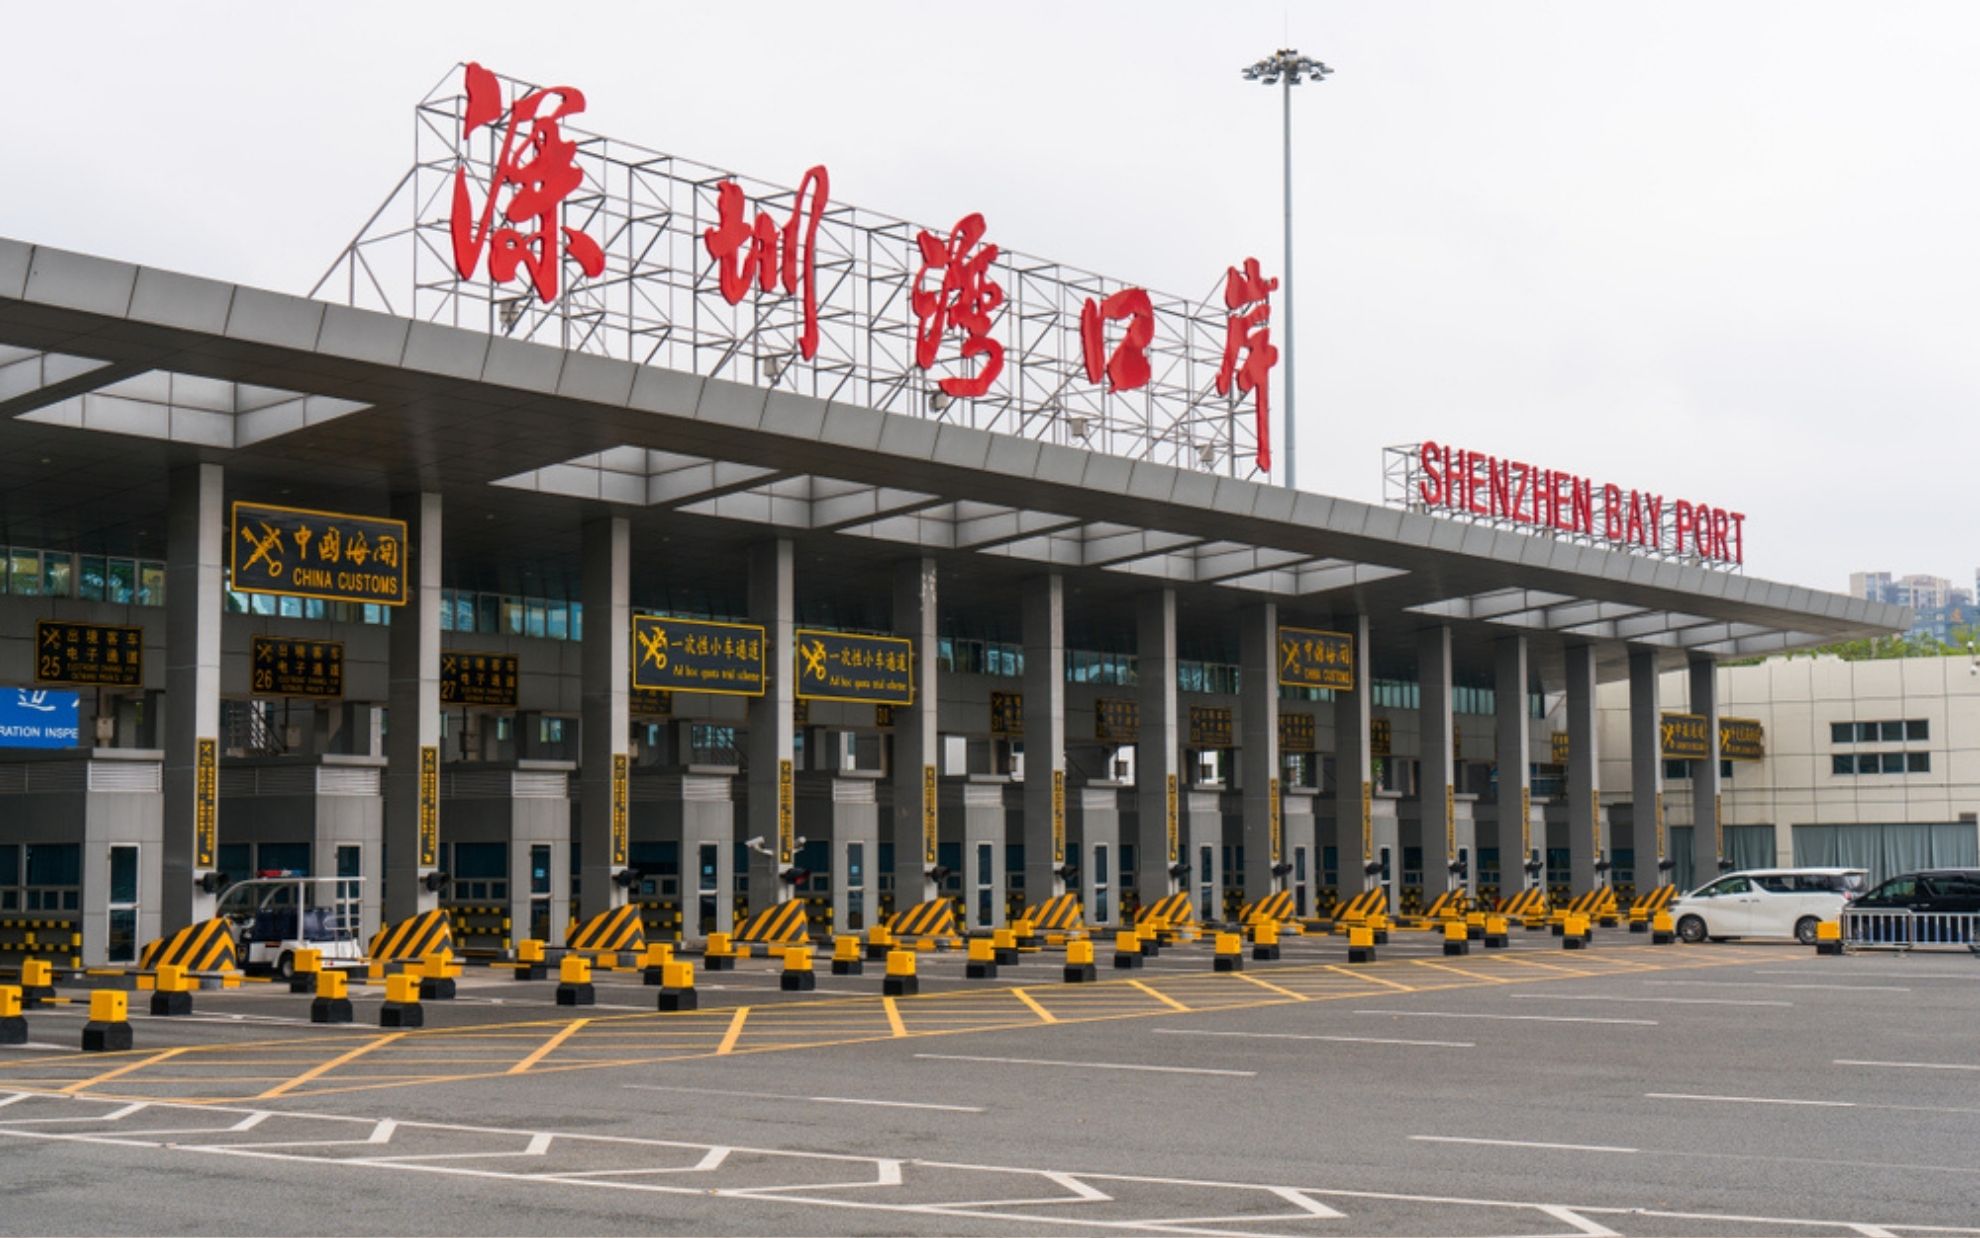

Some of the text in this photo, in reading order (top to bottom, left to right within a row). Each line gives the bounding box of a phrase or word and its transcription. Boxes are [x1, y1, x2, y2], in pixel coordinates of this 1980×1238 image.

[1420, 441, 1745, 565] SHENZHEN BAY PORT
[293, 568, 398, 595] CHINA CUSTOMS
[671, 632, 759, 661] 一次性小车通道
[41, 654, 60, 677] 25
[255, 669, 272, 689] 26
[440, 680, 456, 700] 27
[45, 727, 79, 739] INSPE
